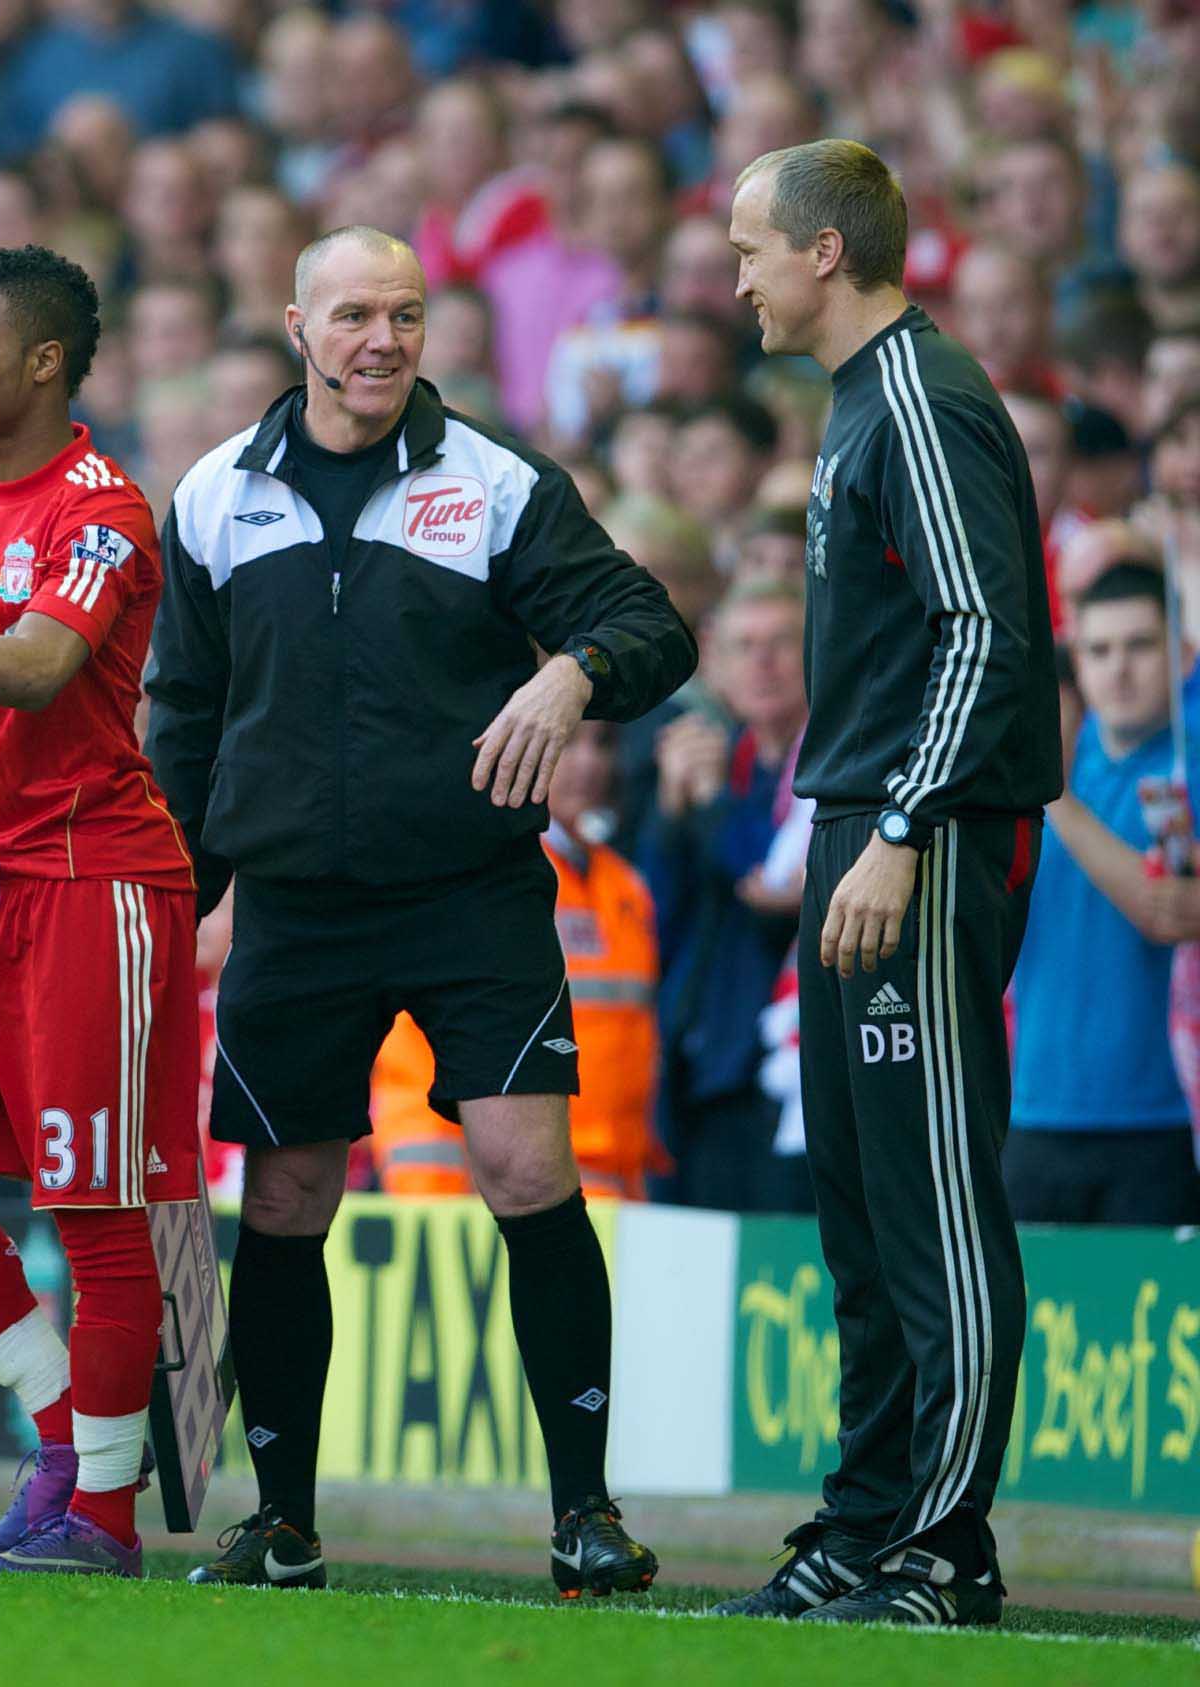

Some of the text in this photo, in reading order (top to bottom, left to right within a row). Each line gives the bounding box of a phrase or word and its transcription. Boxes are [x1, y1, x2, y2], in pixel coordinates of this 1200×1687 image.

[407, 487, 484, 537] Tune
[421, 528, 466, 545] Group
[867, 1002, 911, 1016] adidas
[39, 1106, 109, 1190] 31
